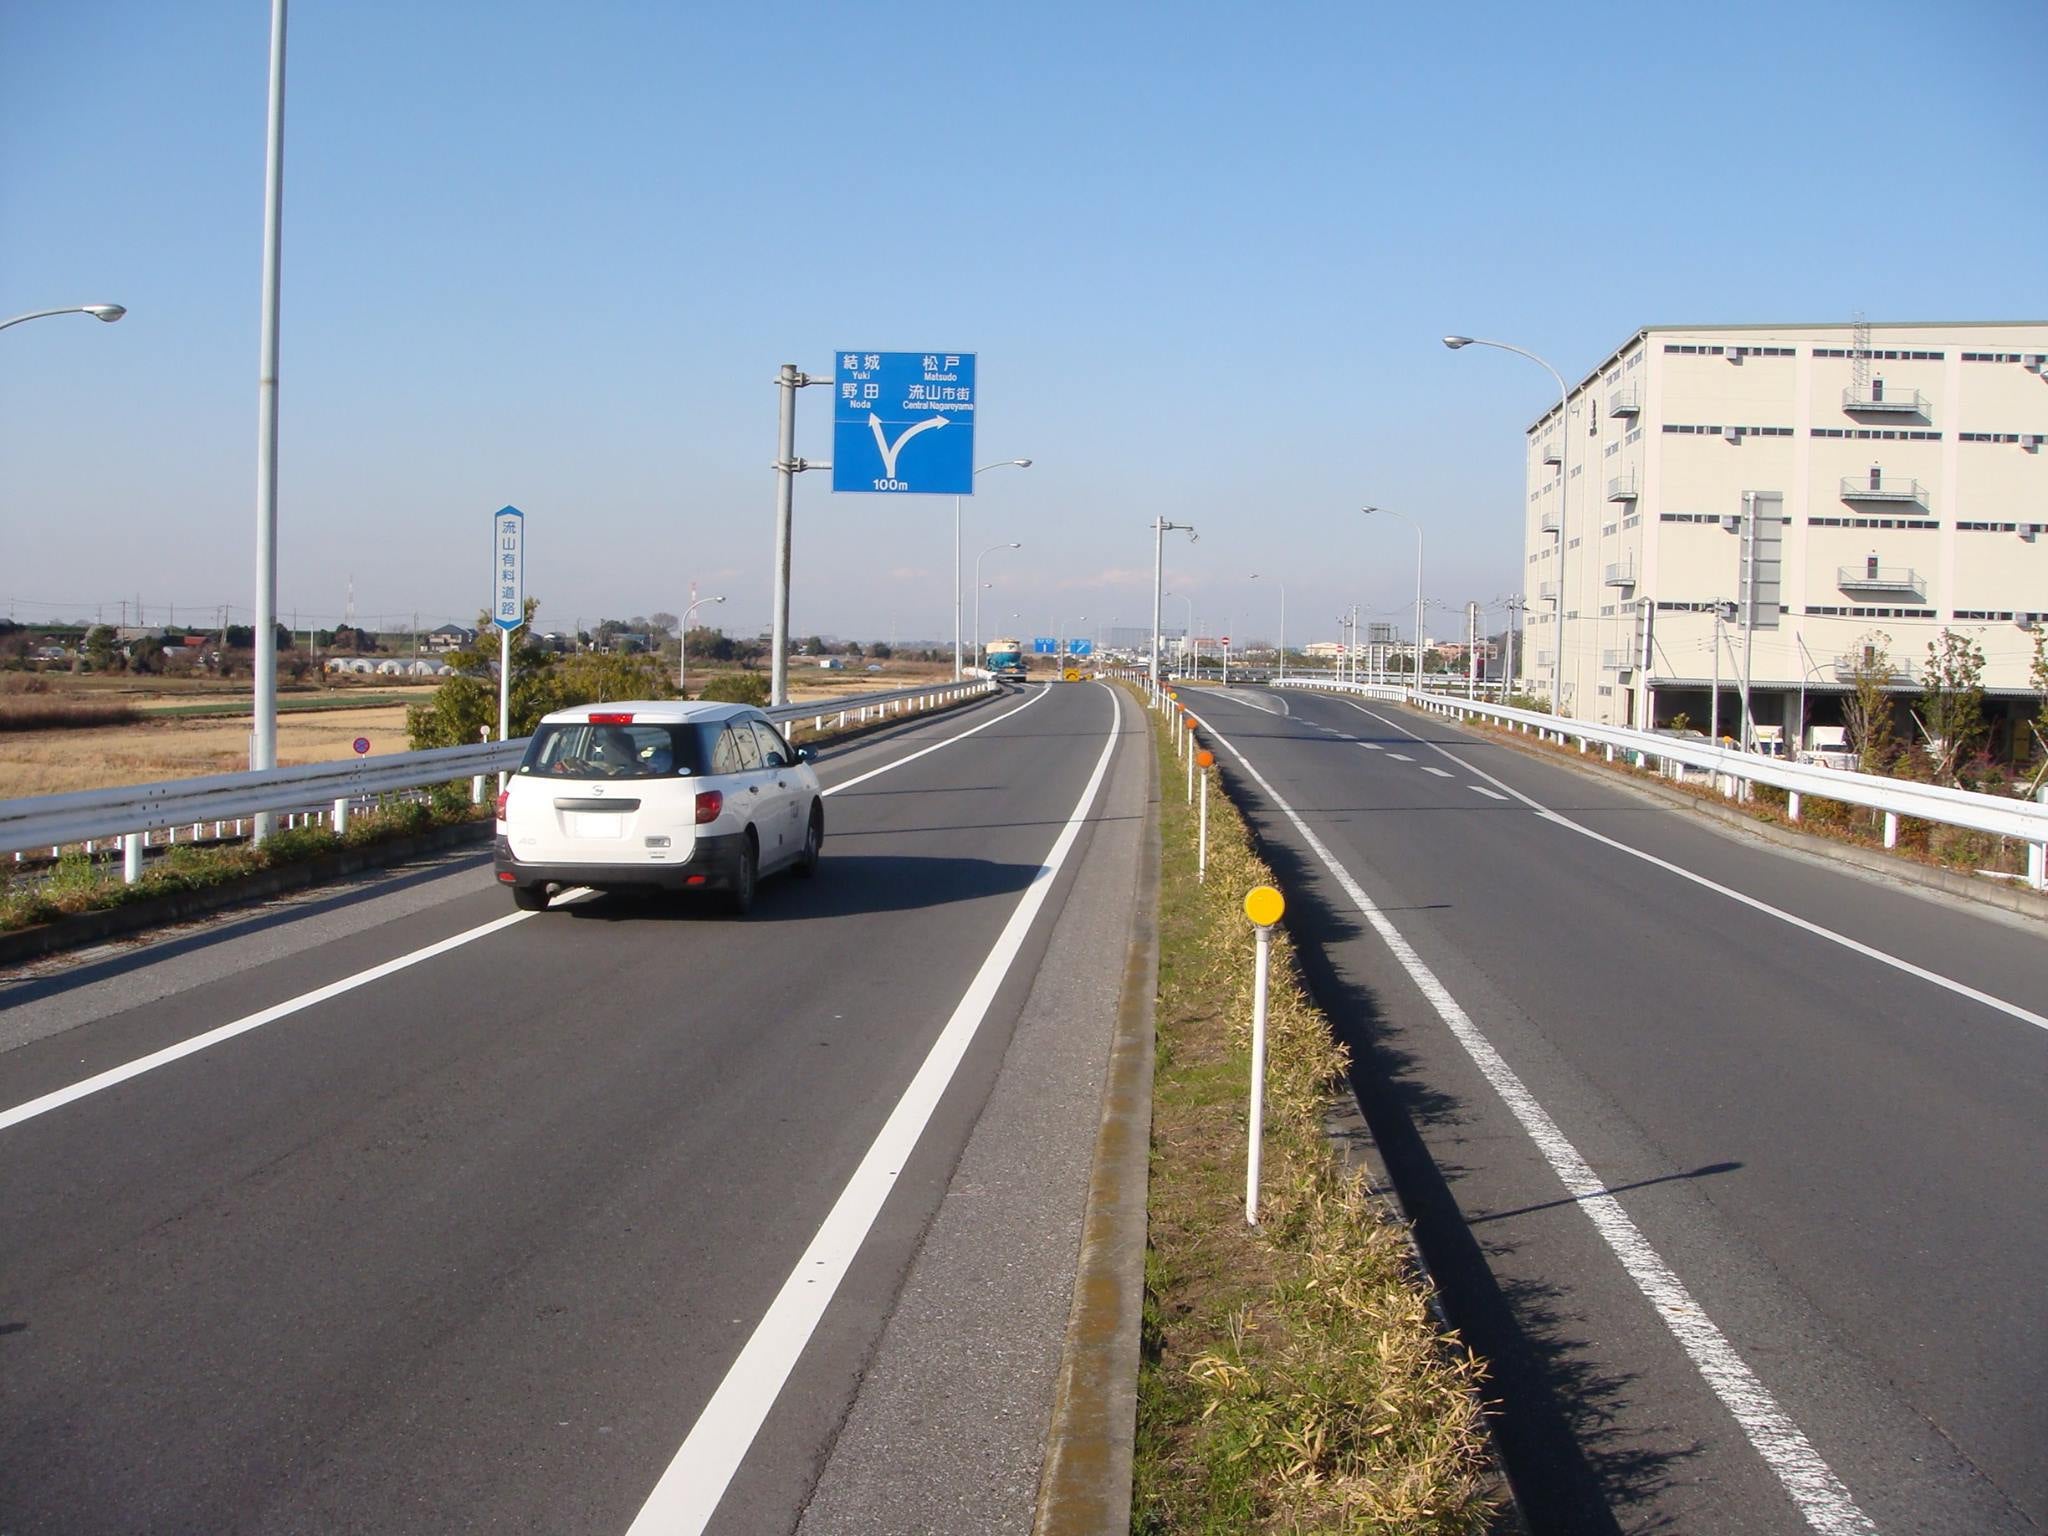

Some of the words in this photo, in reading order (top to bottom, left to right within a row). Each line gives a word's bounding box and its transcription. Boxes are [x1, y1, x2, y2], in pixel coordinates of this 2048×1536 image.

[843, 354, 880, 370] 結城
[923, 355, 960, 371] 松戸
[852, 371, 871, 380] Yuki
[924, 372, 957, 382] Matsudo
[842, 383, 879, 399] 野田
[908, 384, 970, 400] 流山市街
[850, 400, 871, 409] Noda
[903, 400, 928, 410] Central
[873, 479, 908, 491] 100m
[502, 521, 517, 616] 流山有料道路
